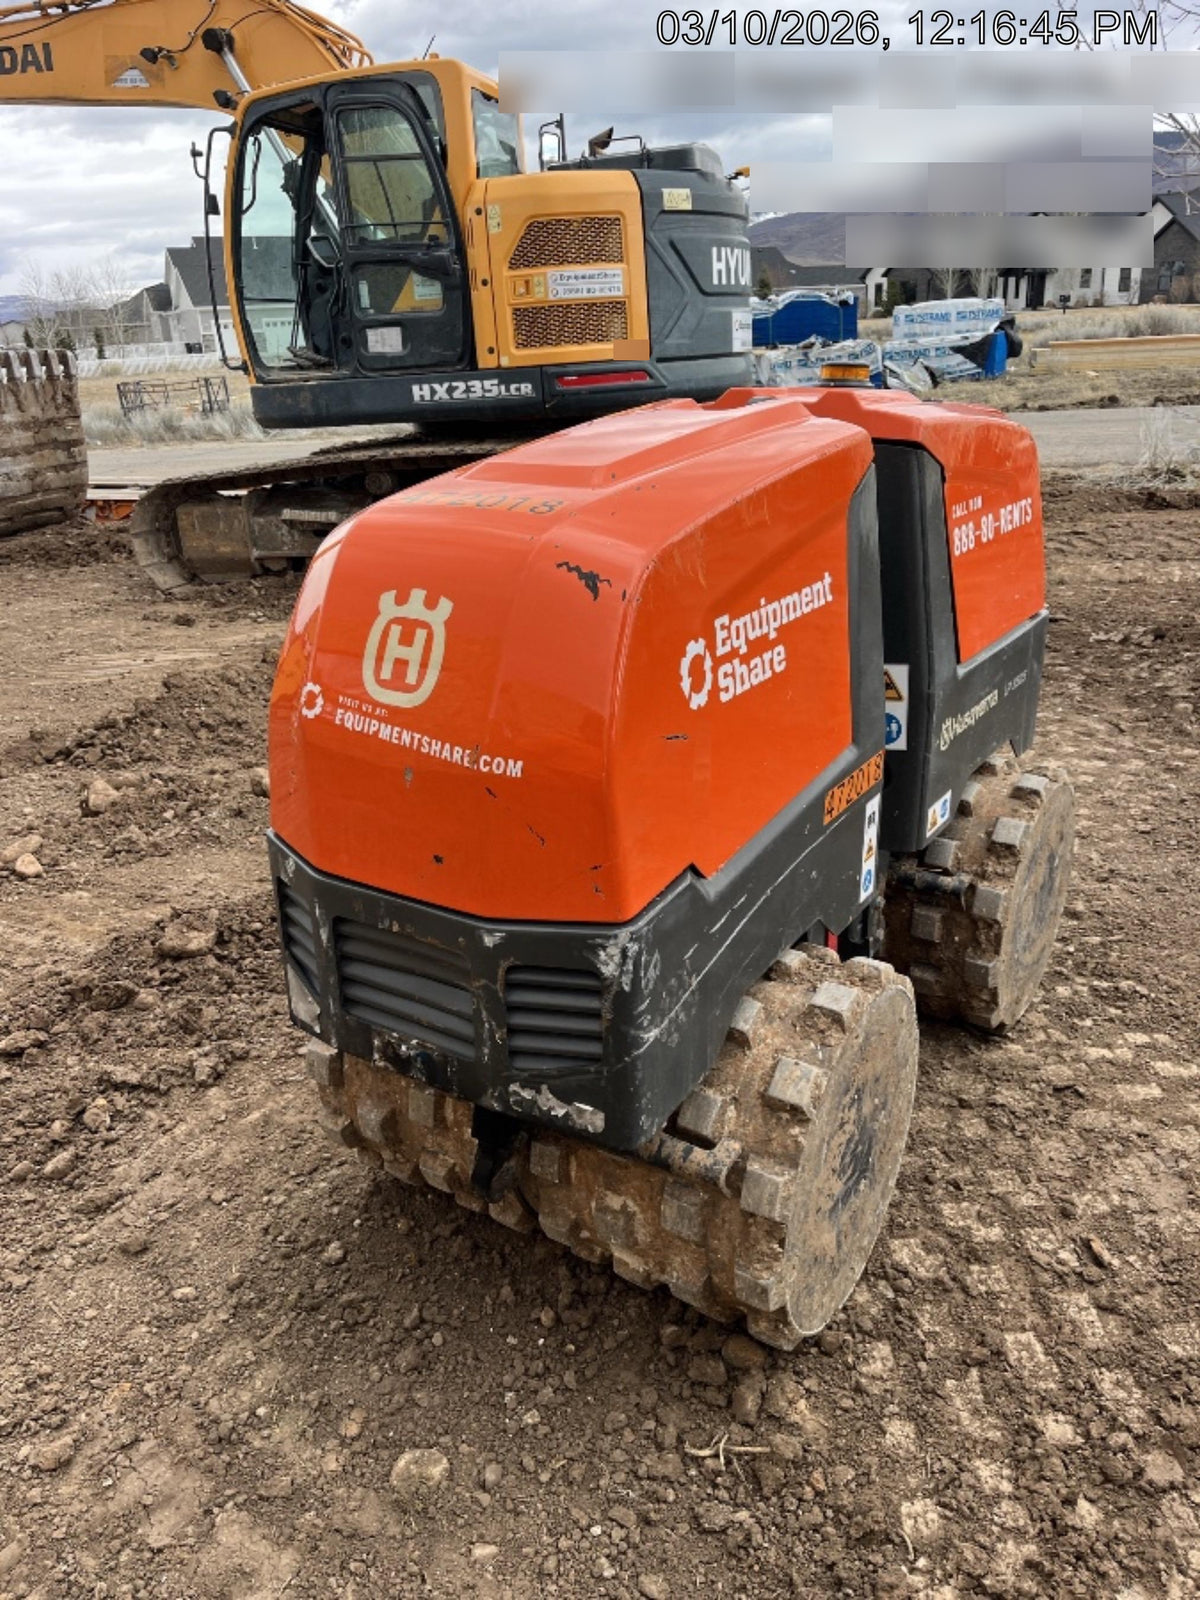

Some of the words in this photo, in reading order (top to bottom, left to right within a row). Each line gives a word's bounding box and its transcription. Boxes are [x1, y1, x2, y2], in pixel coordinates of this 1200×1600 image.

[714, 571, 833, 657] Equipment
[717, 644, 787, 703] Share
[335, 708, 524, 778] EQUIPMENTSHARE.COM
[826, 752, 882, 818] 472018
